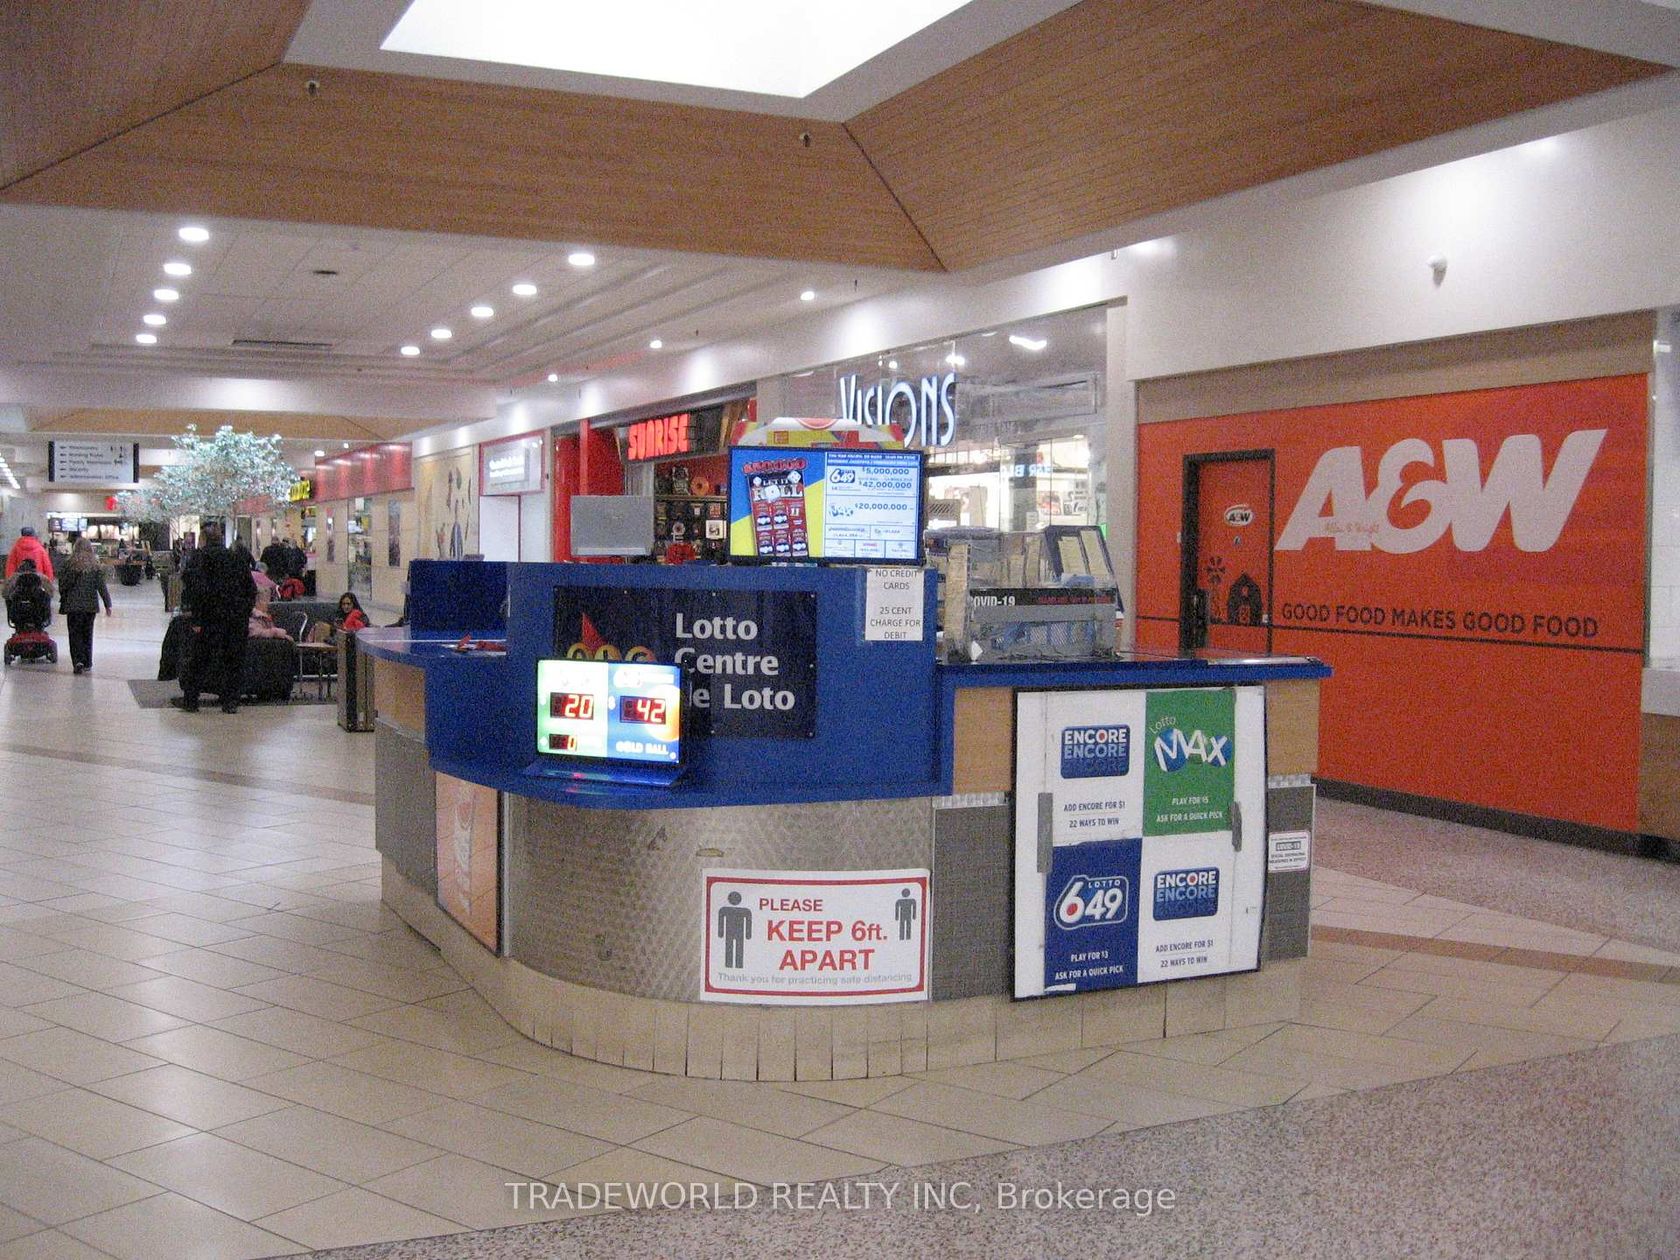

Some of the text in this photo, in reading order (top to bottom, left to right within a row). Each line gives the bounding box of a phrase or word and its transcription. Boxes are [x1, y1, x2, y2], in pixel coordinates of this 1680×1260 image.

[627, 413, 689, 460] SUNRISE
[1274, 429, 1608, 554] A&W
[876, 570, 918, 578] NO CREDIT
[880, 606, 912, 614] 25 CENT
[675, 612, 758, 640] Lotto
[870, 619, 920, 627] CHARGE FOR
[1282, 603, 1598, 638] GOOD FOOD MAKES GOOD FOOD
[884, 632, 907, 640] DEBIT
[674, 647, 779, 676] Centre
[724, 683, 796, 711] Loto
[564, 694, 594, 718] 20
[637, 699, 665, 722] 42
[1149, 716, 1176, 734] Lotto
[1064, 728, 1127, 744] ENCORE
[1064, 744, 1127, 760] ENCORE
[1154, 728, 1228, 772] MAX
[1064, 800, 1126, 812] ADD ENCORE FOR $1
[1172, 796, 1188, 806] PLAY
[1188, 796, 1201, 804] FOR
[1070, 820, 1078, 828] 22
[1080, 818, 1096, 827] WAYS
[1098, 818, 1106, 826] TO
[1156, 814, 1168, 822] ASK
[1170, 813, 1182, 822] FOR
[1189, 812, 1208, 820] QUICK
[1088, 880, 1120, 888] LOTTO
[1156, 870, 1216, 889] ENCORE
[1156, 885, 1216, 902] ENCORE
[759, 898, 823, 912] PLEASE
[767, 920, 888, 942] KEEP 6ft.
[1156, 945, 1168, 953] ADD
[1170, 942, 1192, 952] ENCORE
[1194, 940, 1206, 949] FOR
[778, 948, 875, 971] APART
[1071, 953, 1086, 962] PLAY
[1088, 952, 1100, 960] FOR
[1170, 958, 1186, 966] WAYS
[1188, 957, 1194, 965] TO
[718, 972, 912, 986] Thank you for practicing safe distancing
[1055, 972, 1068, 980] ASK
[1069, 970, 1082, 979] FOR
[1089, 967, 1108, 976] QUICK
[1110, 965, 1124, 974] PICK
